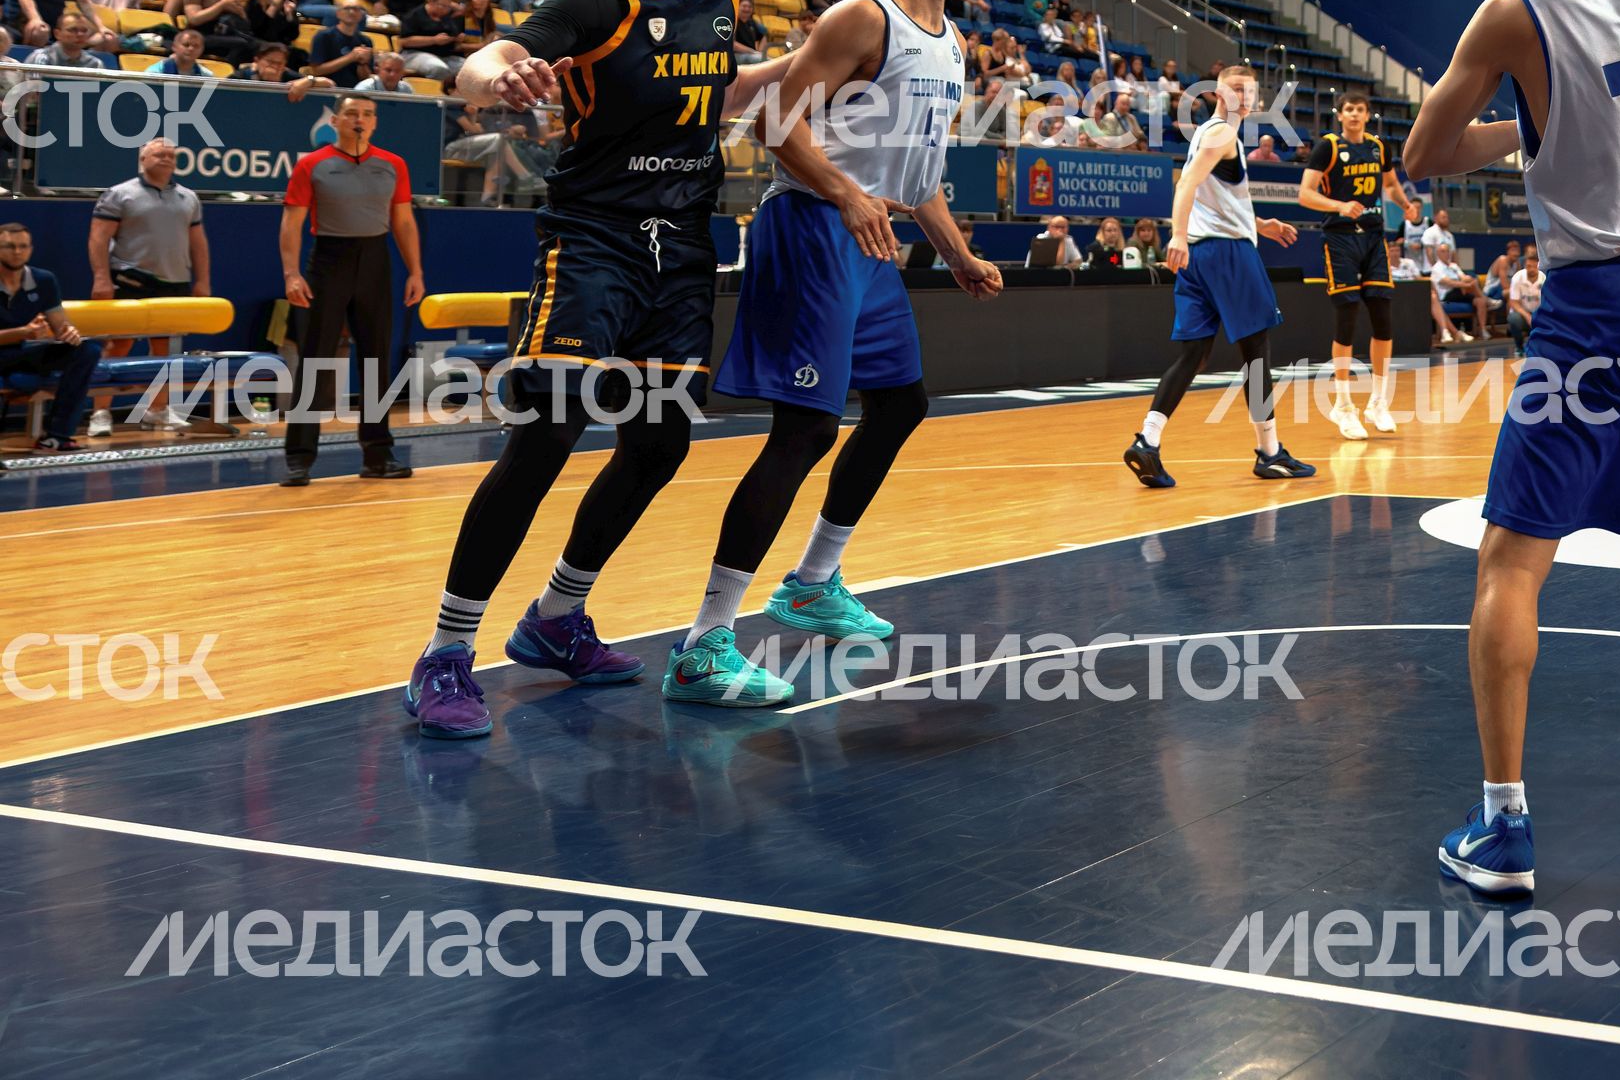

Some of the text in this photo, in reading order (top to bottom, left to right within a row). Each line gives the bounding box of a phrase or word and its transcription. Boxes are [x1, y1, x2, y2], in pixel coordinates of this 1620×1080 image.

[653, 52, 728, 78] ХИМКИ
[676, 85, 712, 126] 71
[139, 147, 312, 178] ОСОБЛ
[1059, 161, 1162, 179] ПРАВИТЕЛЬСТВО
[1059, 177, 1148, 194] МОСКОВСКОЙ
[1353, 176, 1376, 195] 50
[1059, 193, 1120, 208] ОБЛАСТИ
[554, 336, 582, 347] ZEDO
